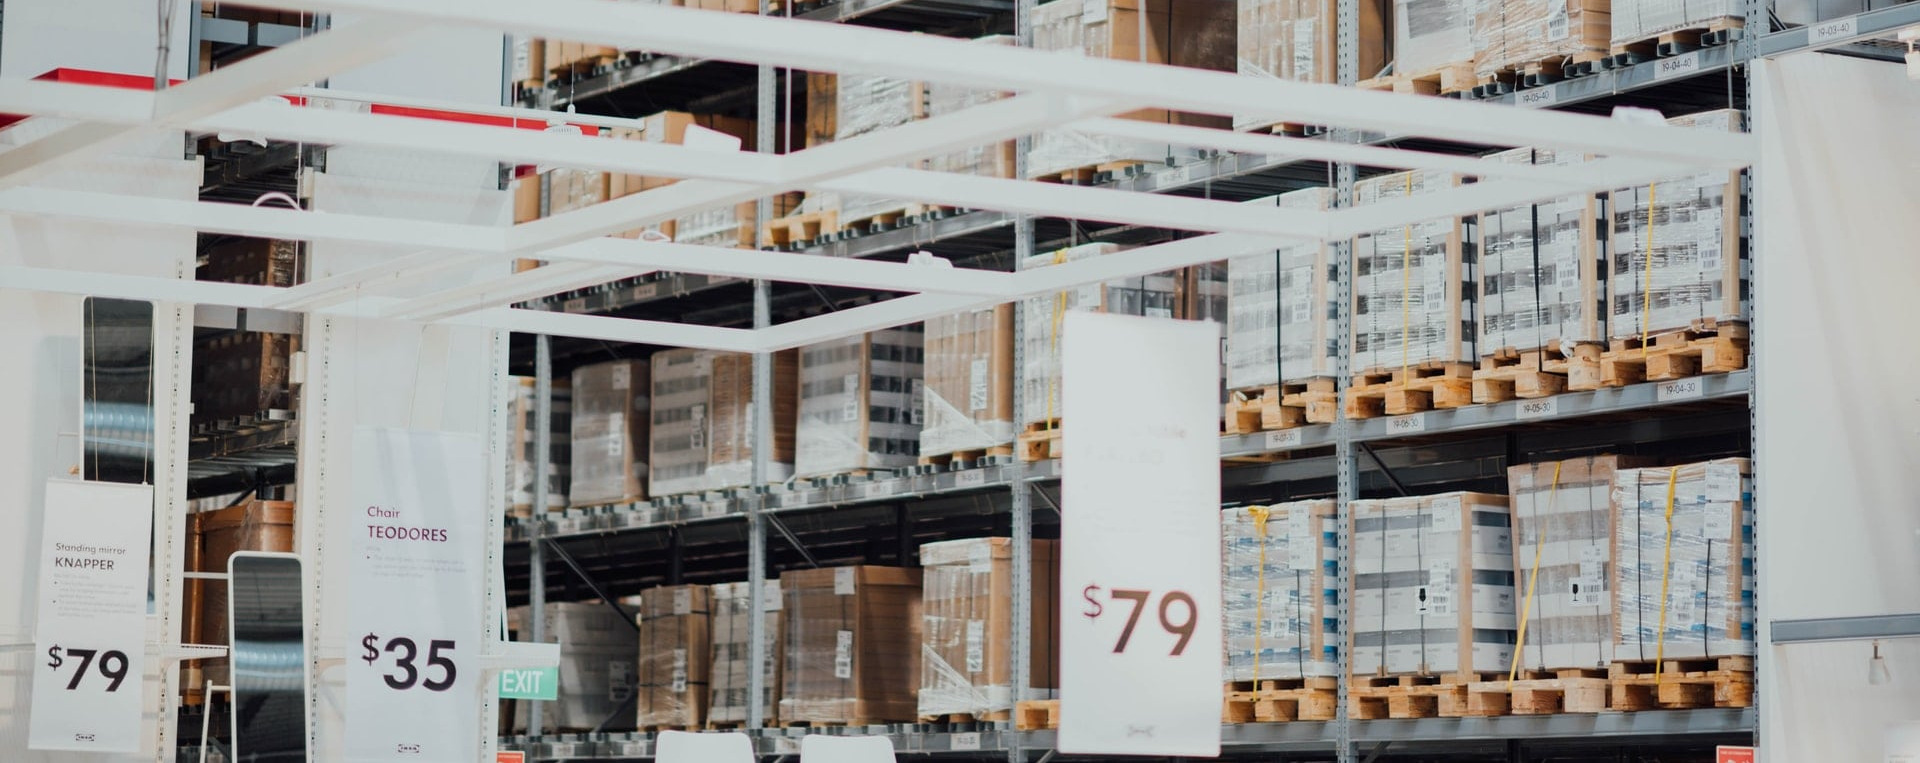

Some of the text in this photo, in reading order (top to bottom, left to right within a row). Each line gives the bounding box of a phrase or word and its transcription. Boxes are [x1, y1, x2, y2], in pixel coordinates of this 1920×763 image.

[1662, 57, 1692, 72] 19-04-40
[1522, 91, 1550, 103] 19-05-40
[1665, 382, 1696, 395] 19-04-30
[1523, 402, 1550, 414] 19-05-30
[367, 506, 401, 519] Chair
[367, 525, 448, 542] TEODORES
[55, 542, 127, 555] Standing mirror
[55, 557, 115, 570] KNAPPER
[1083, 582, 1198, 657] $79
[47, 643, 129, 692] $79
[361, 632, 457, 692] $35
[501, 669, 544, 694] EXIT
